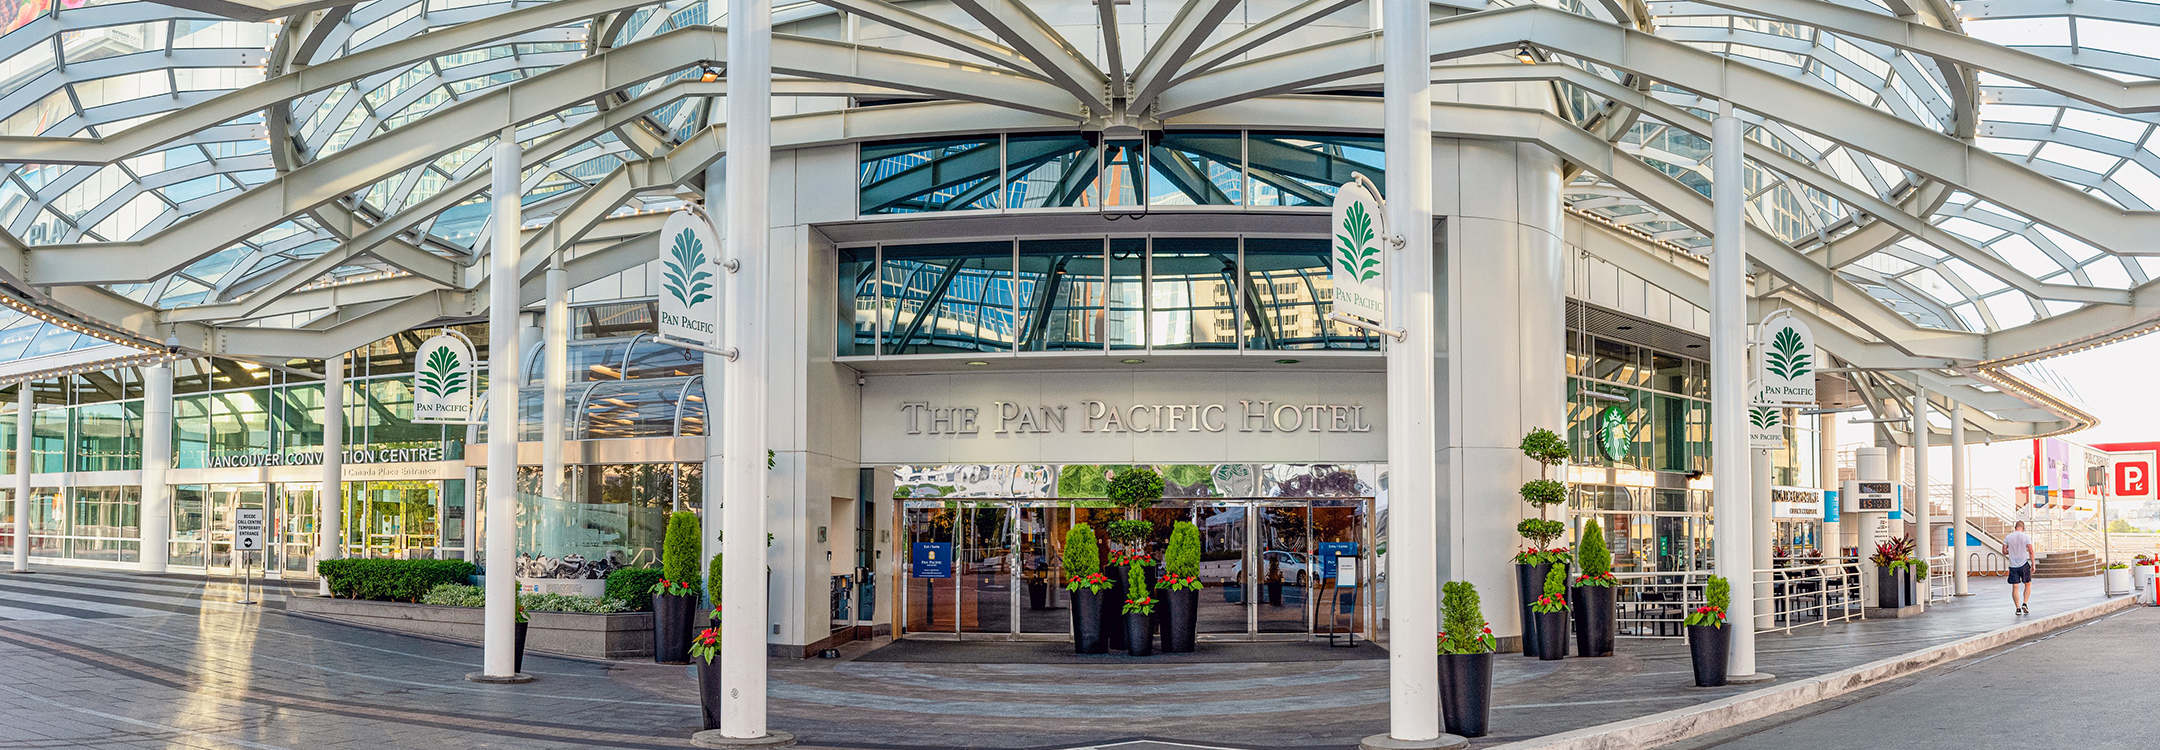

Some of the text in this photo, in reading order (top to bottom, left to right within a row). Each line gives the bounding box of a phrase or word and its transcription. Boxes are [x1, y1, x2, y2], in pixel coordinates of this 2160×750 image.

[1336, 287, 1383, 313] PAN PACIFIC
[661, 311, 714, 334] PAN PACIFIC
[1765, 385, 1814, 396] PAN PACIFIC
[416, 402, 468, 412] PAN PACIFIC
[900, 399, 1371, 435] THE PAN PACIFIC HOTEL
[207, 447, 437, 468] VANCOUVER CONVTION CENTRE
[348, 465, 436, 477] Canada Place Entrance
[2124, 466, 2143, 491] P
